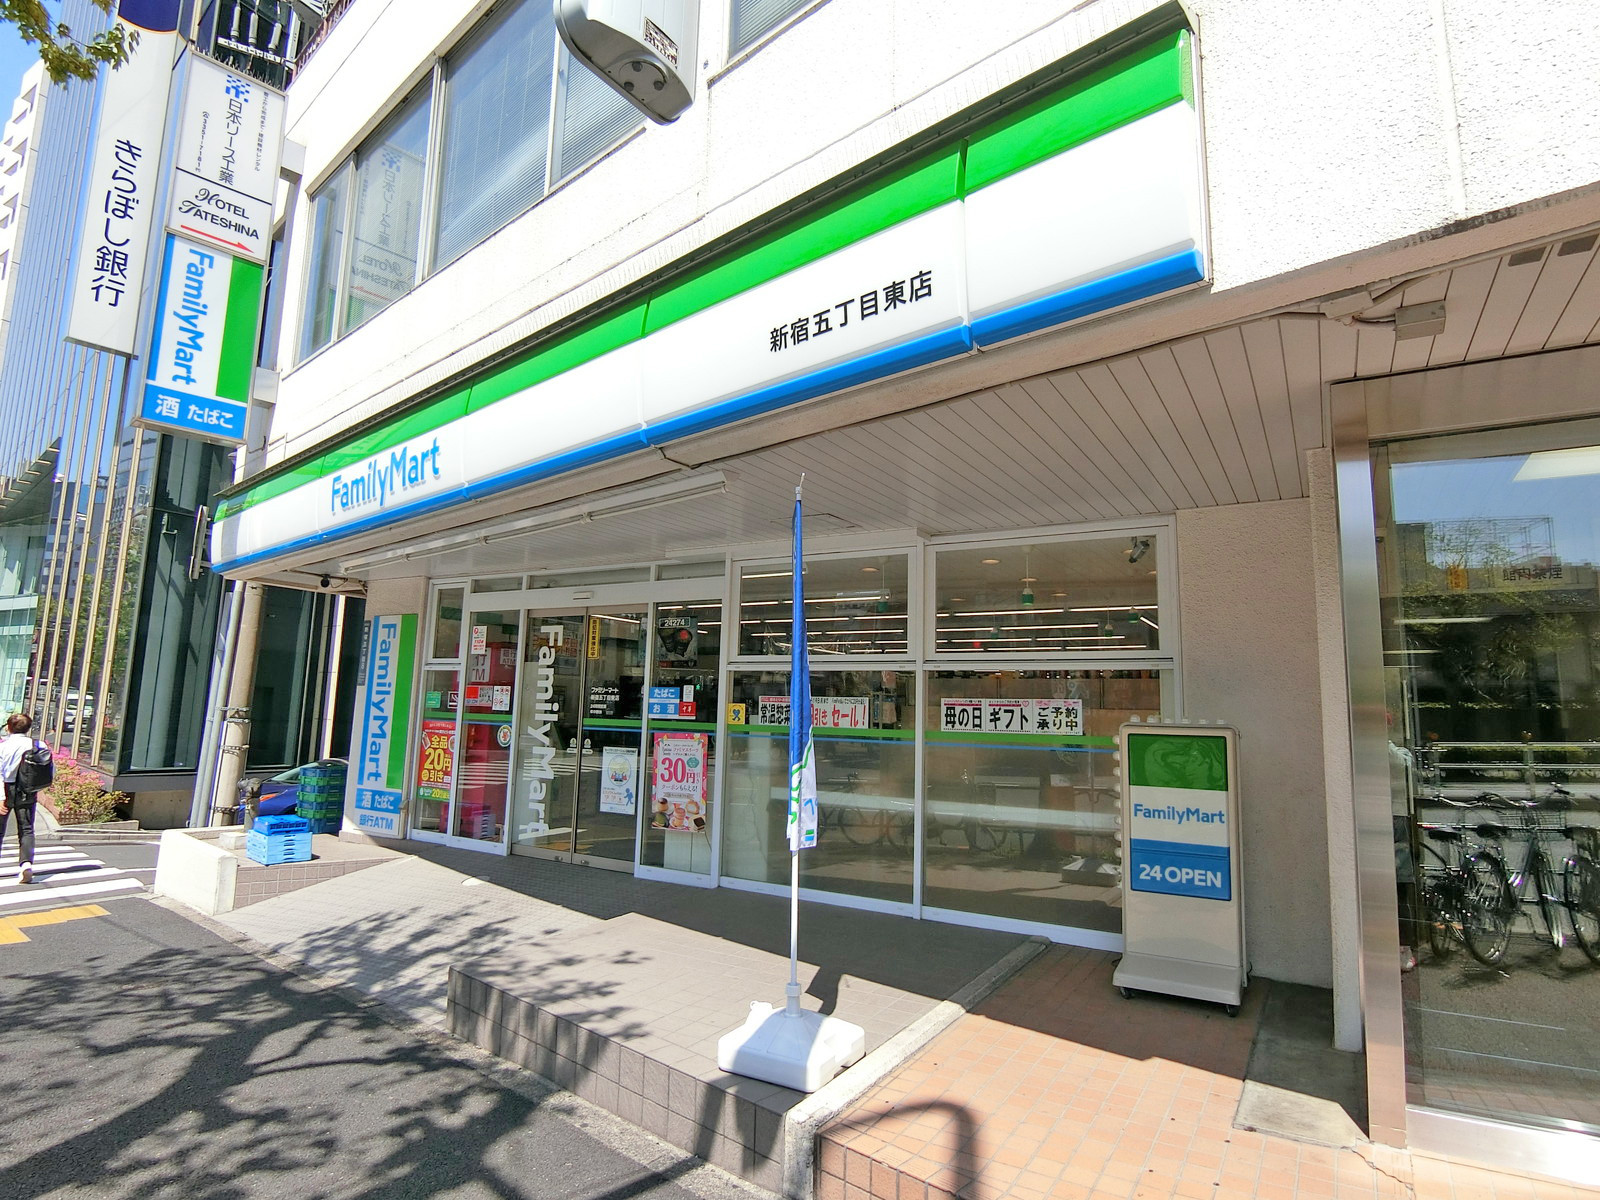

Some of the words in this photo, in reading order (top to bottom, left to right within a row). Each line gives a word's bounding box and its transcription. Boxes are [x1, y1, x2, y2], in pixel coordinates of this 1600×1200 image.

[218, 98, 243, 186] 日本リース工業
[195, 188, 250, 220] HOTEL
[91, 139, 142, 307] きらぼし銀行
[178, 200, 260, 240] TATESHINA
[171, 248, 214, 386] FamilyMart
[770, 270, 932, 353] 新宿五丁目東店
[155, 394, 181, 419] 酒
[187, 404, 234, 429] たばこ
[331, 437, 440, 512] FamilyMart
[367, 623, 397, 782] FamilyMart
[653, 688, 675, 698] たばこ
[944, 706, 982, 729] 母の日
[989, 707, 1029, 731] ギフト
[1036, 719, 1078, 731] 承り中
[1037, 706, 1078, 719] ご予約
[431, 735, 448, 749] 全品
[527, 625, 564, 836] FamilyMart
[424, 748, 452, 771] 20円
[660, 757, 696, 784] 30円
[429, 770, 444, 782] 引き
[361, 791, 372, 809] 酒
[374, 794, 394, 809] たばこ
[359, 814, 393, 830] 銀行ATM
[1134, 803, 1225, 825] FamilyMart
[1139, 864, 1162, 881] 24
[1164, 866, 1222, 888] OPEN
